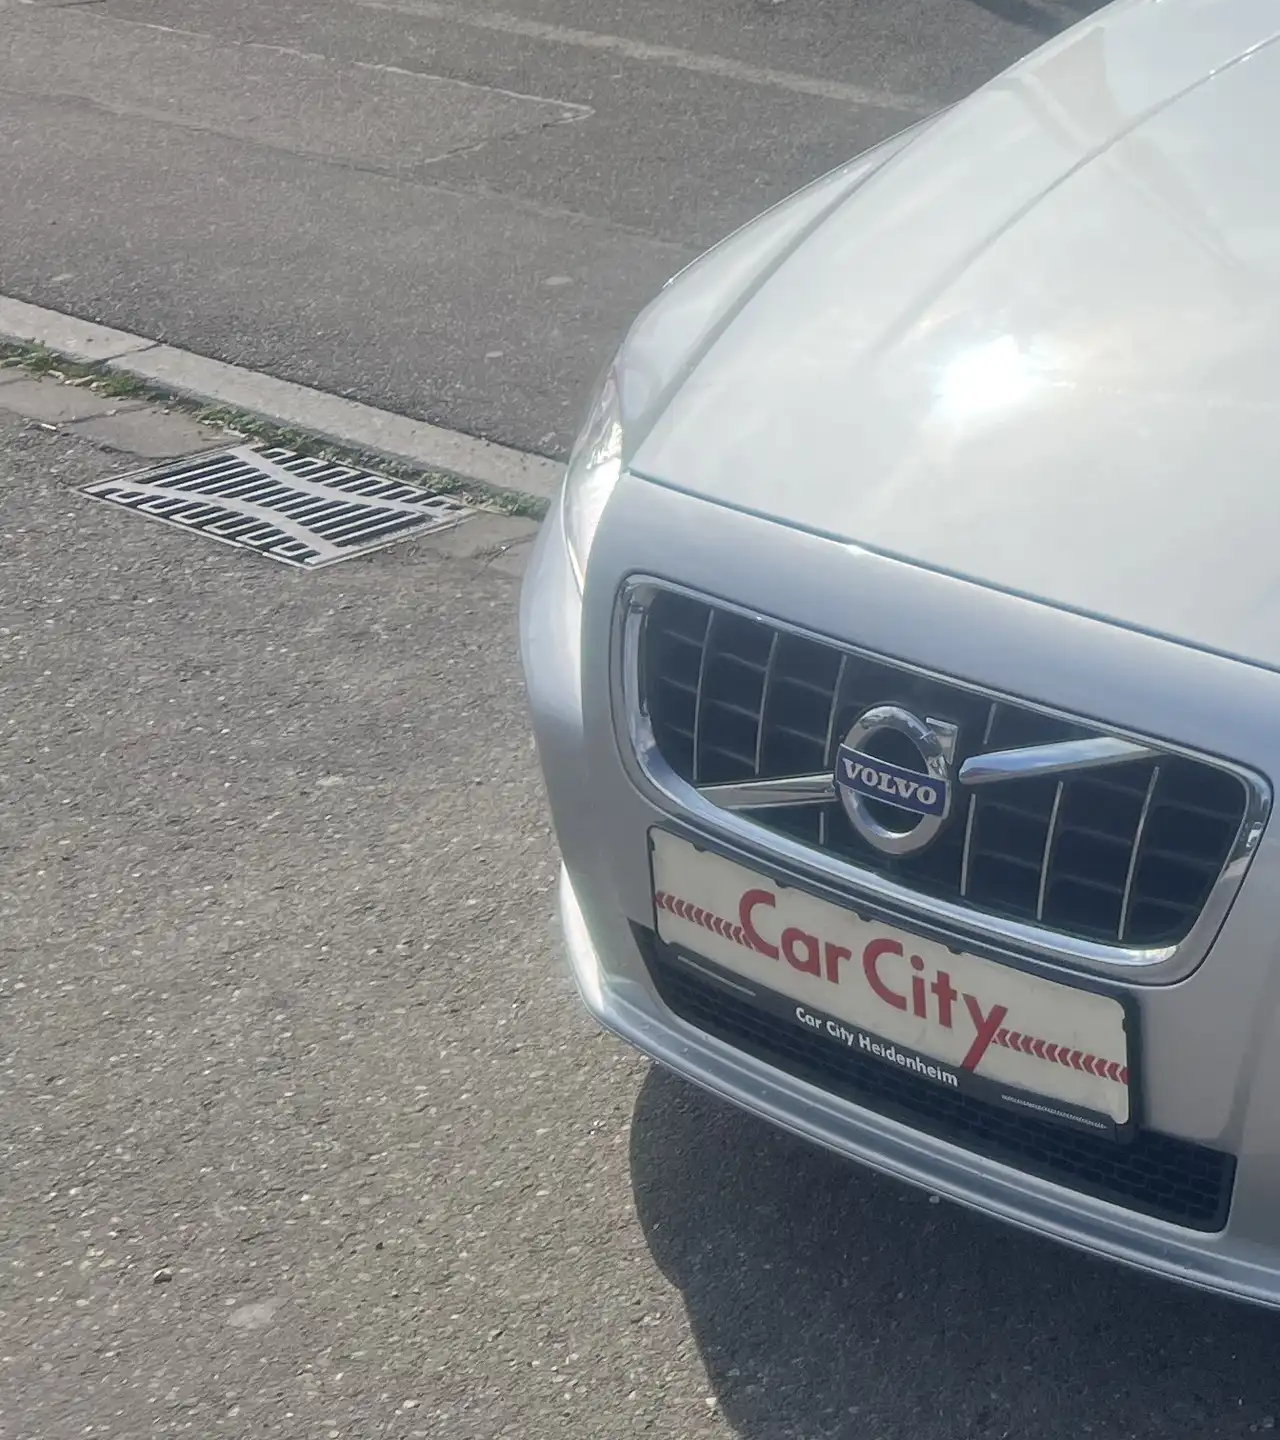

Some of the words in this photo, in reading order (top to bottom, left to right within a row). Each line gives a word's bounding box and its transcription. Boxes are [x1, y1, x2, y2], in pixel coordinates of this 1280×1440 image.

[841, 757, 937, 805] VOLVO
[738, 888, 852, 985] Car
[862, 937, 1009, 1073] City
[795, 1006, 823, 1030] Car
[826, 1019, 855, 1047] City
[858, 1032, 959, 1088] Heidenheim
